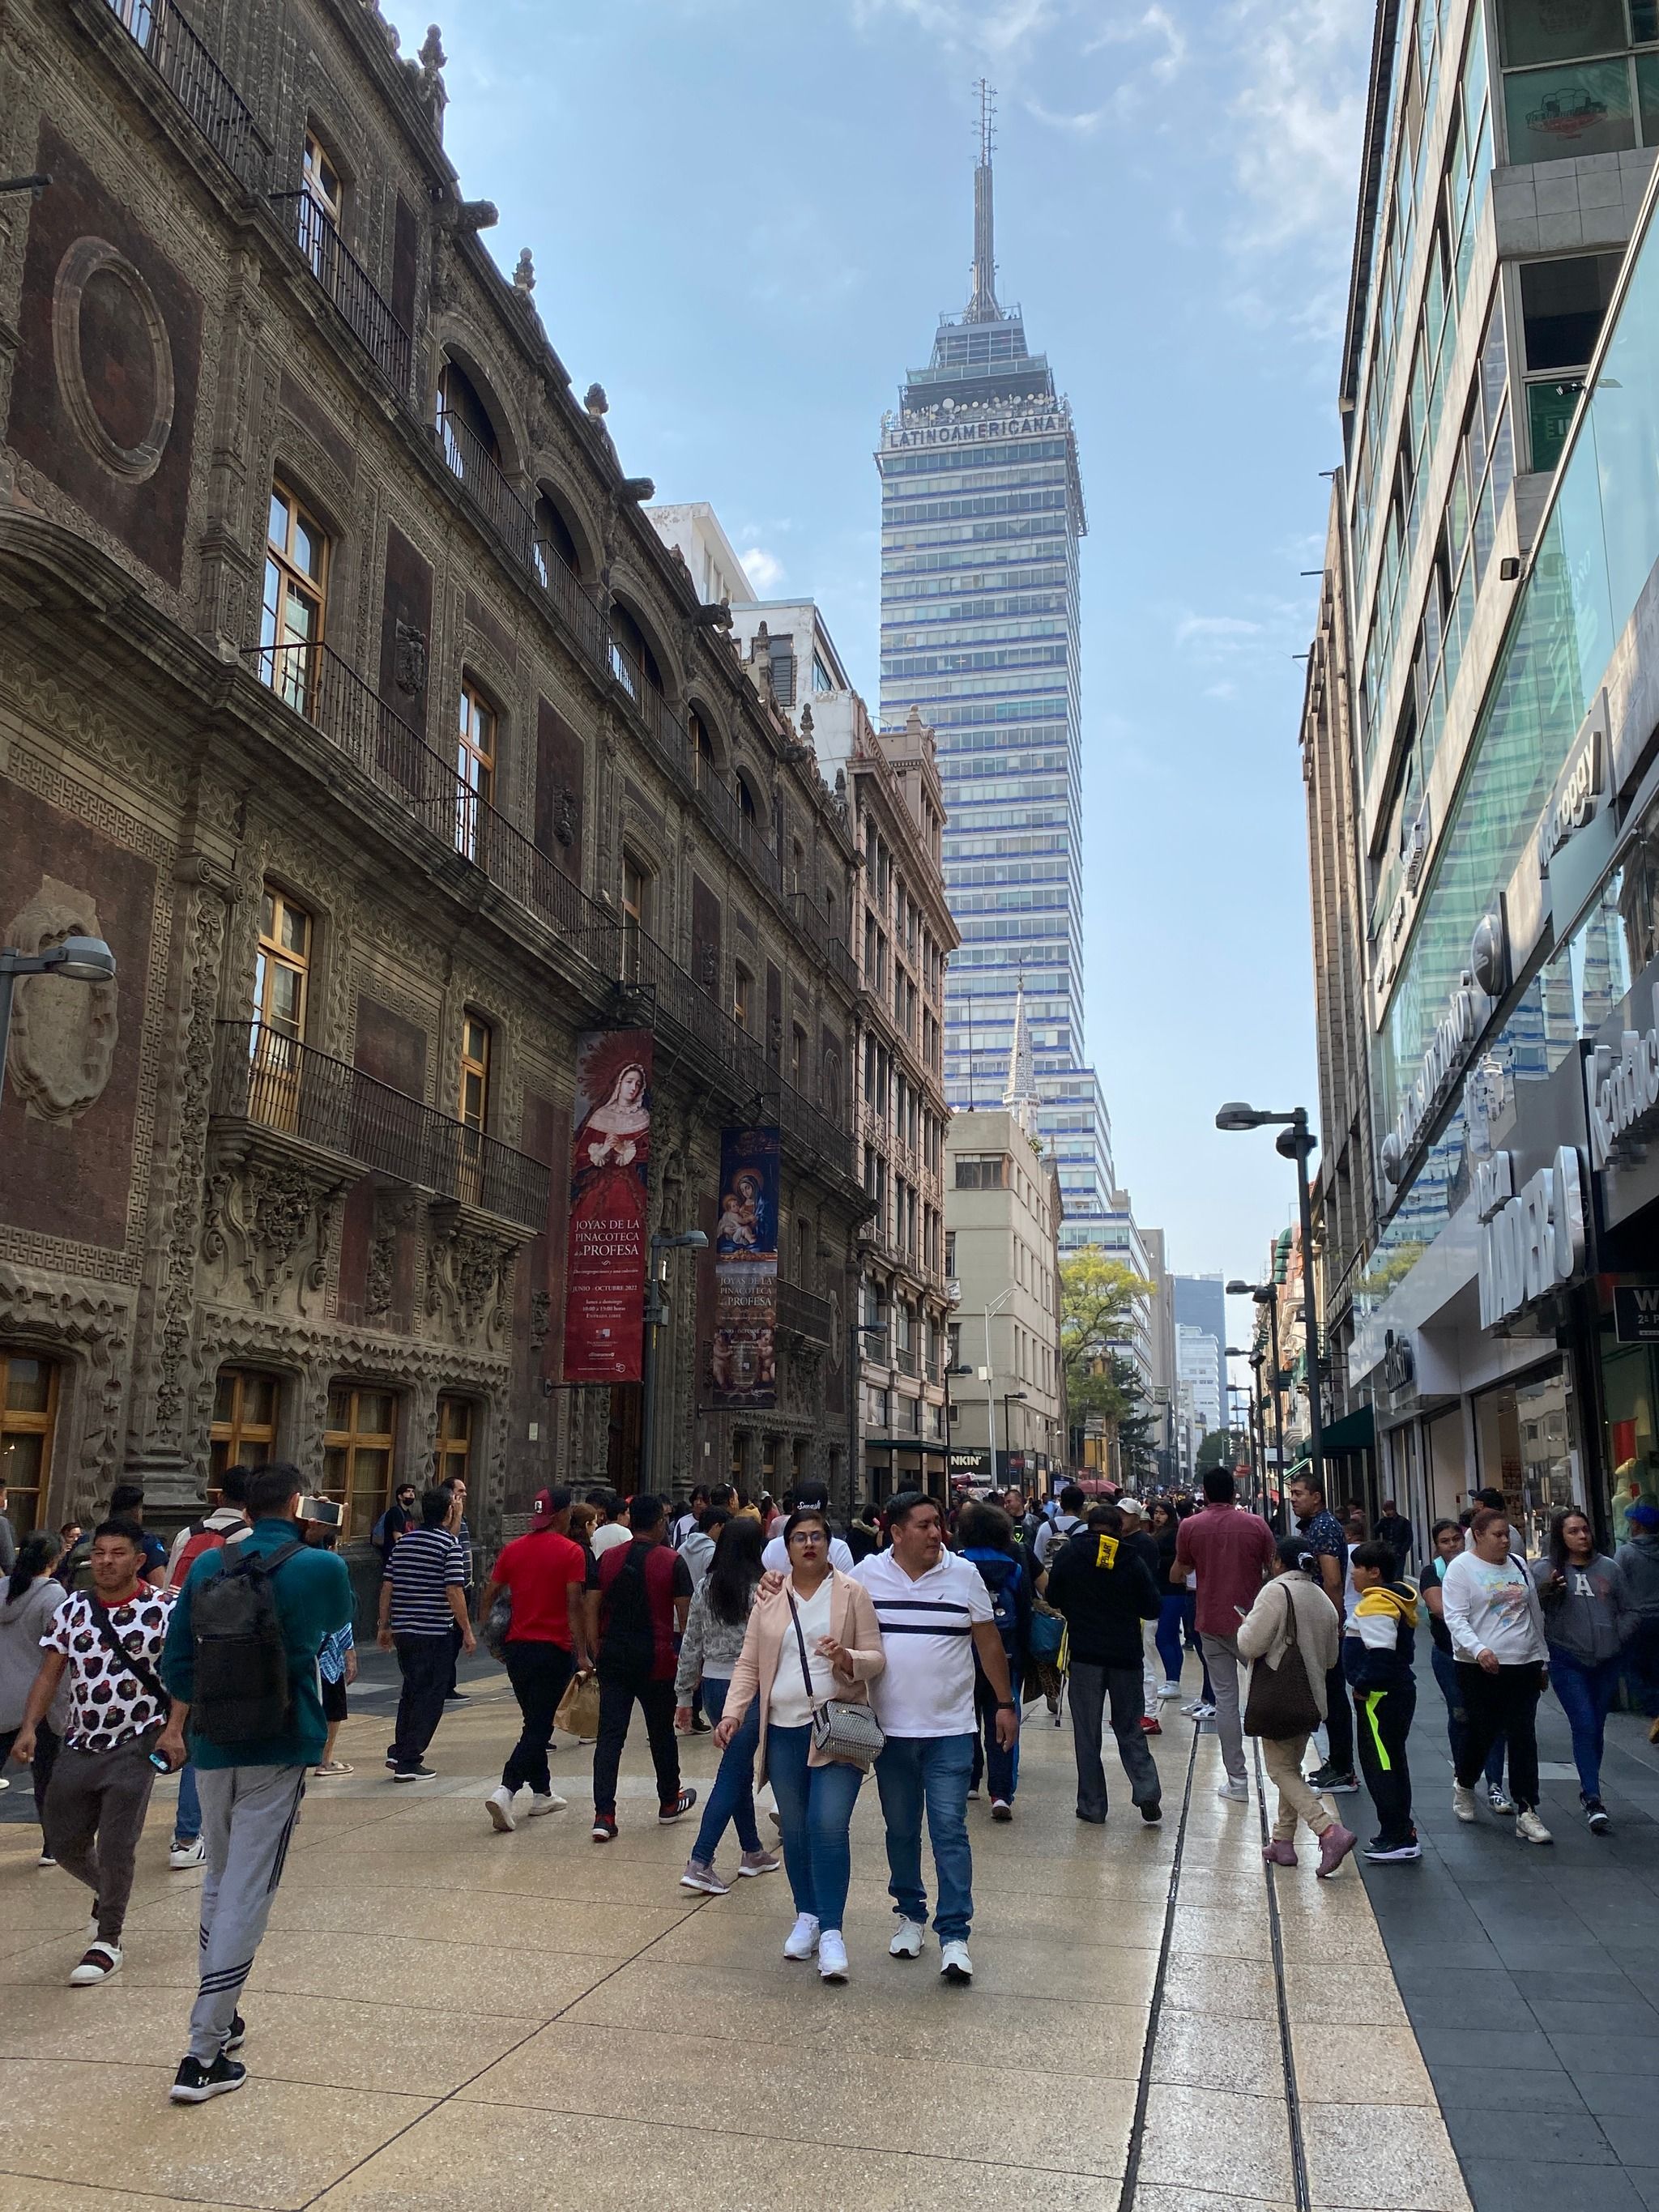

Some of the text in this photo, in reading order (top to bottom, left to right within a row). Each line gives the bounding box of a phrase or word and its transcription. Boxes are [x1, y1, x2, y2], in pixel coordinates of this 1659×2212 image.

[891, 416, 1056, 447] LATINOAMERICANA
[575, 1219, 639, 1232] JOYAS DE LA
[575, 1232, 640, 1242] PINACOTECA
[583, 1244, 639, 1255] PROFESA
[720, 1277, 745, 1286] JOYAS
[728, 1297, 771, 1306] PROFESA
[1575, 1573, 1595, 1597] A
